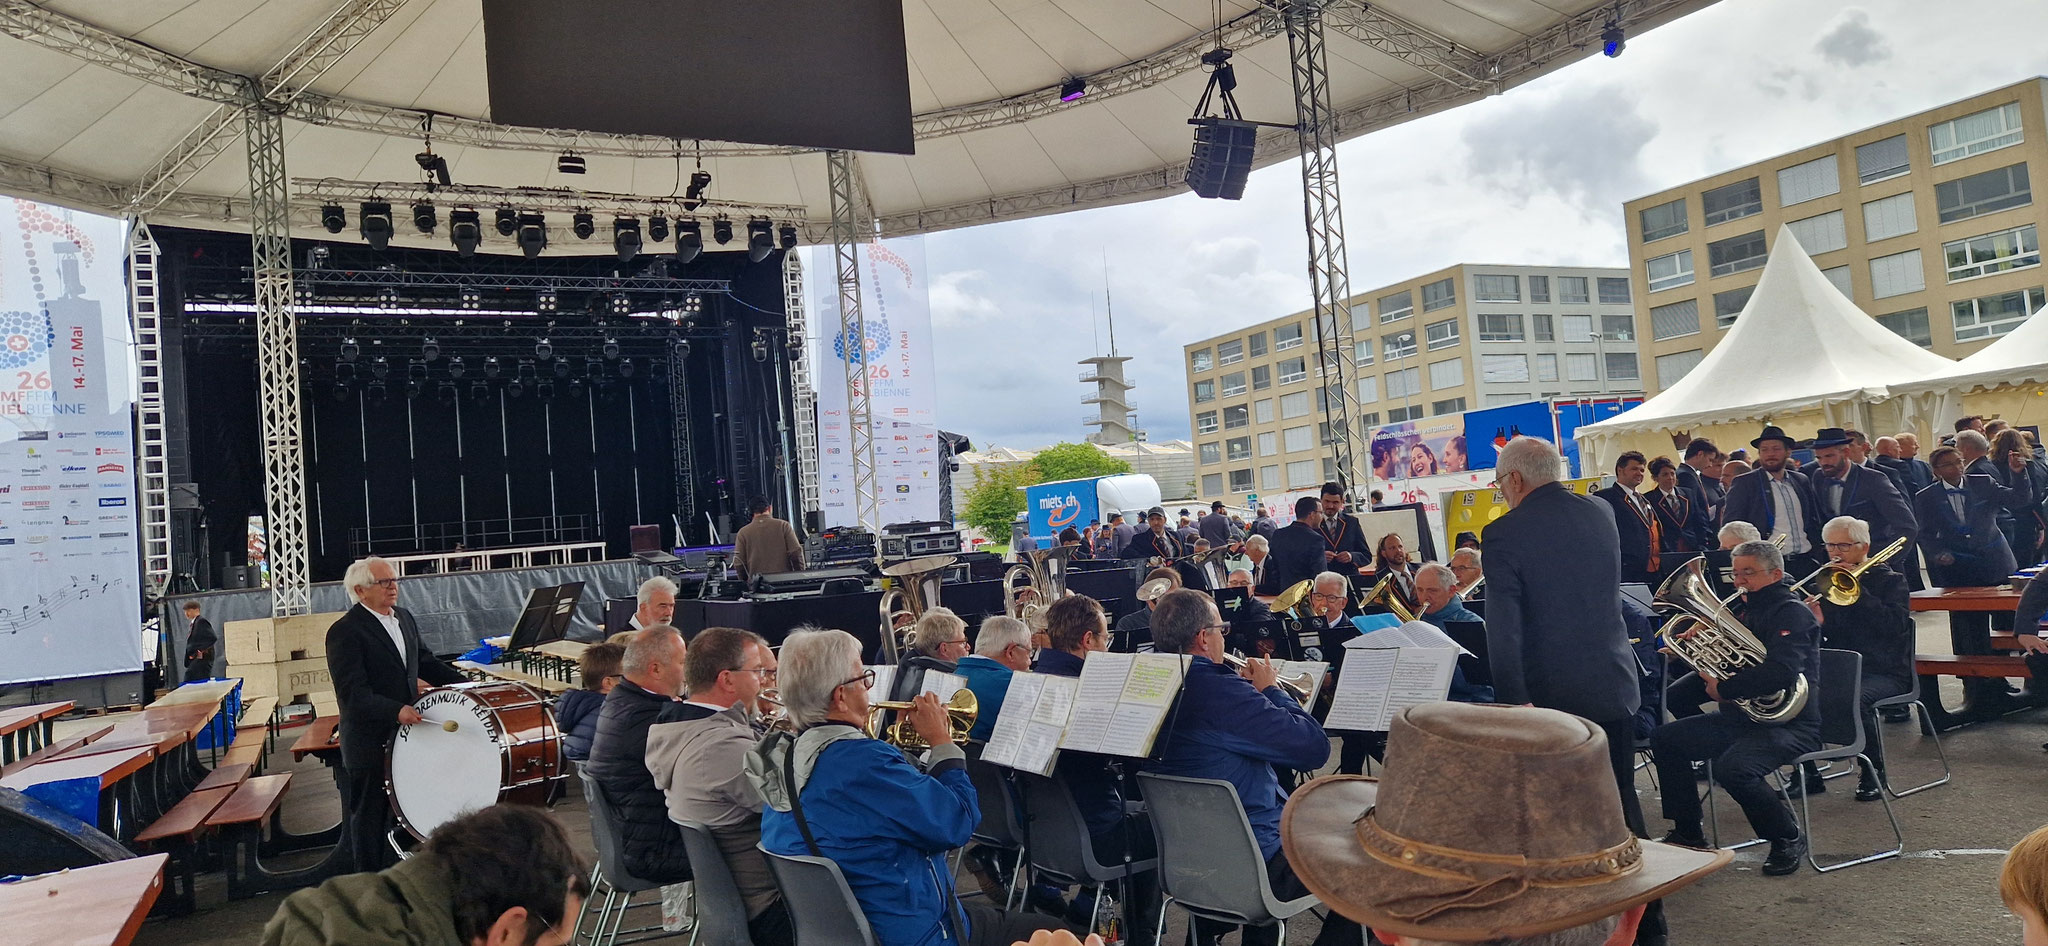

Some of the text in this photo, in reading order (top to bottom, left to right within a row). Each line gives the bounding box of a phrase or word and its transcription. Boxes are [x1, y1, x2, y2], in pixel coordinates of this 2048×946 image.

[70, 326, 85, 388] 14.-17. Mai
[900, 331, 910, 377] 14.-17. Mai
[17, 371, 50, 389] 26
[869, 365, 889, 378] 26
[1040, 491, 1077, 510] miets.ch
[1401, 490, 1416, 504] 26
[1423, 503, 1440, 511] BIEL
[400, 692, 468, 742] SENORENMUSIK
